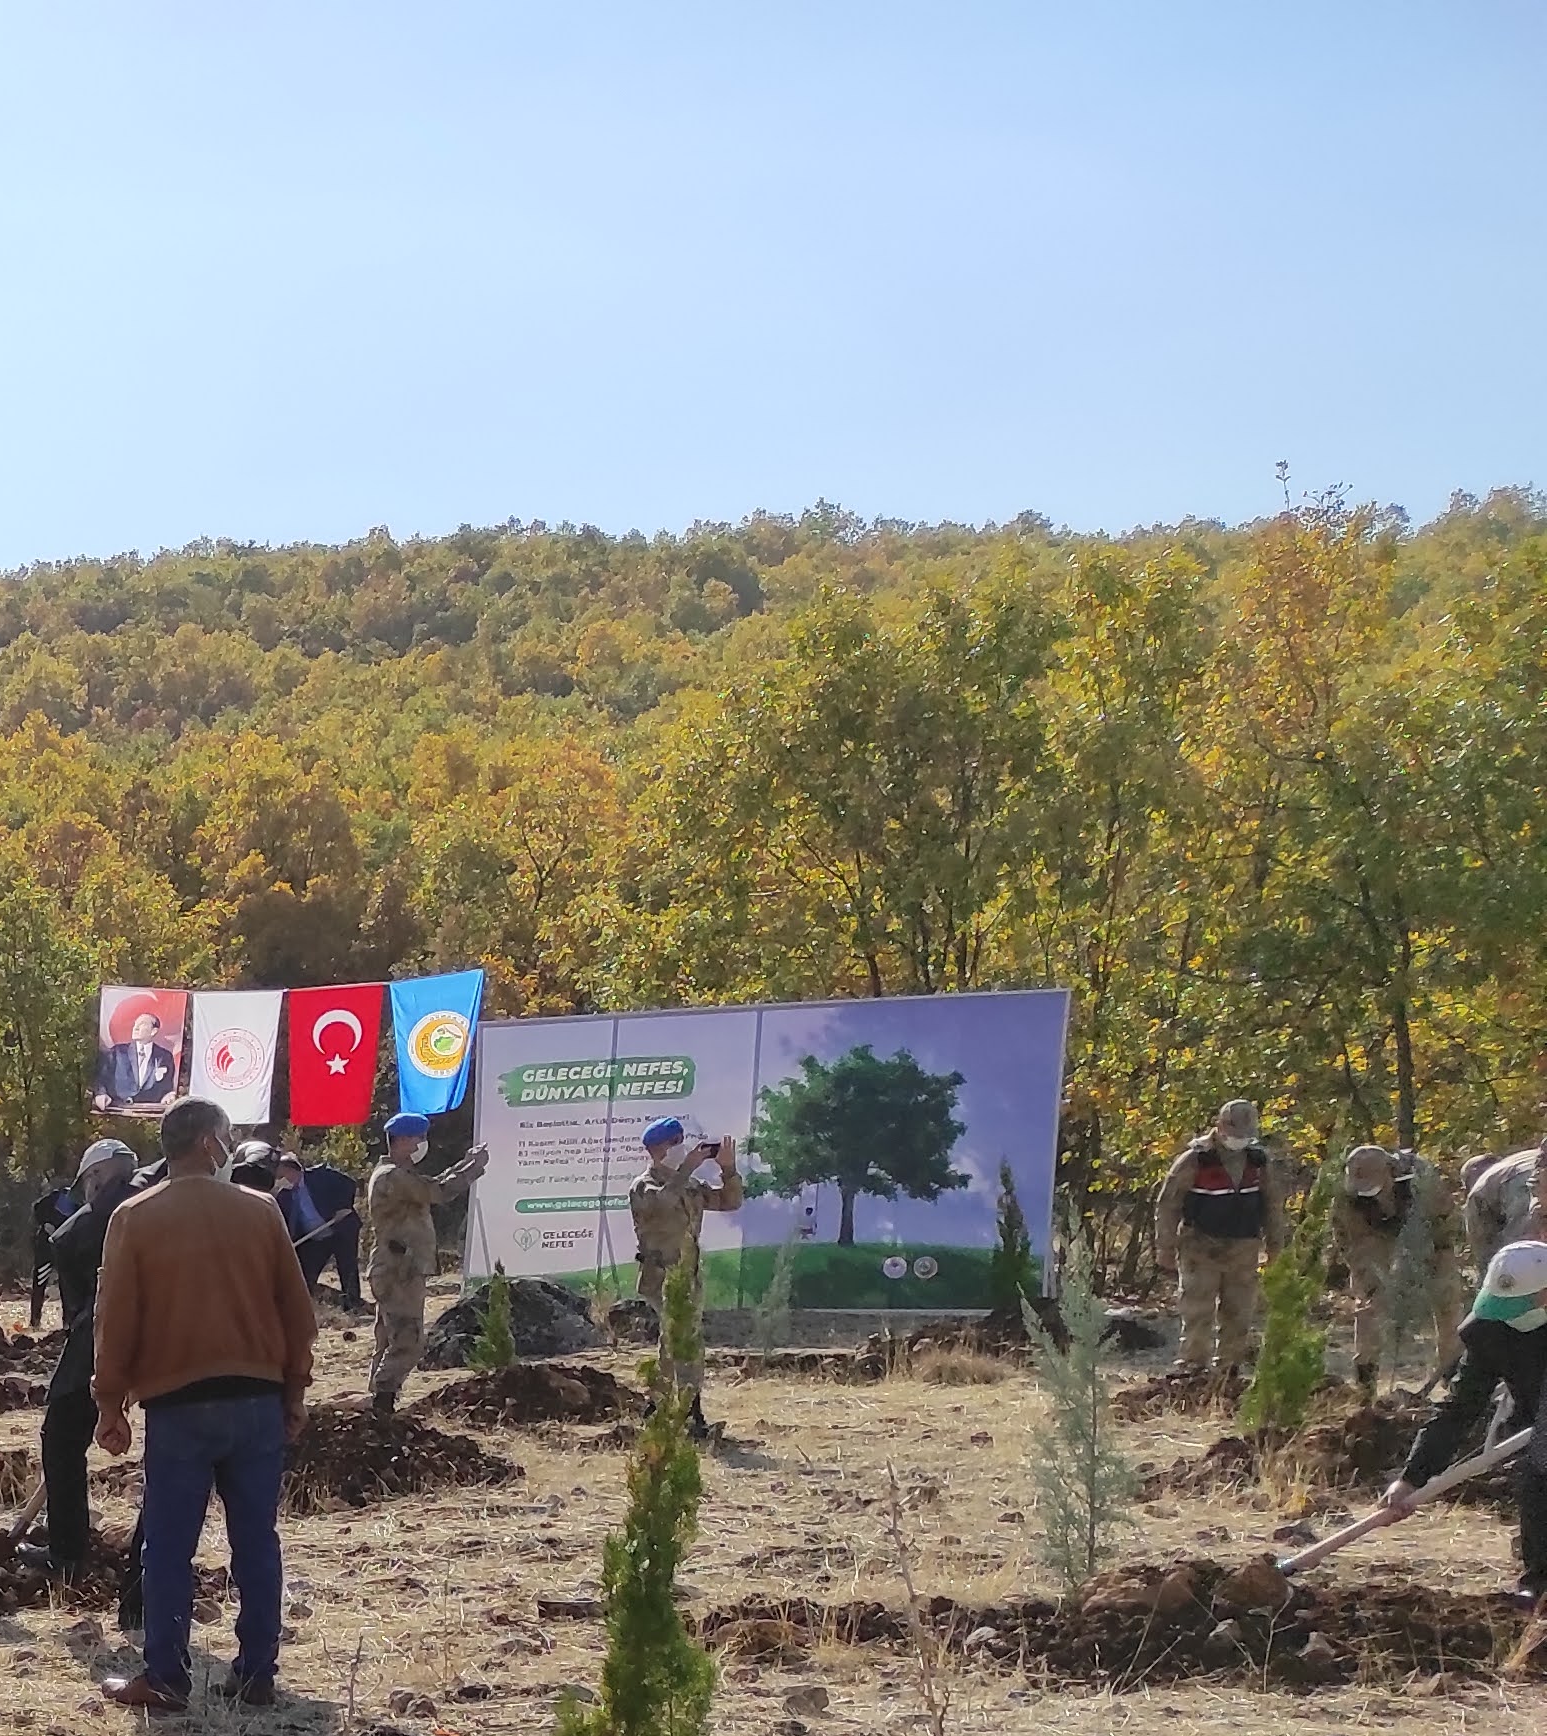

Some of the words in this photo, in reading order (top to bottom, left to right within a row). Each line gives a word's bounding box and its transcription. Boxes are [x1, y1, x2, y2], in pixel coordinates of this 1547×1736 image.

[522, 1061, 618, 1083] GELECEĞE
[622, 1061, 689, 1077] NEFES,
[520, 1084, 610, 1102] DÜNYAYA
